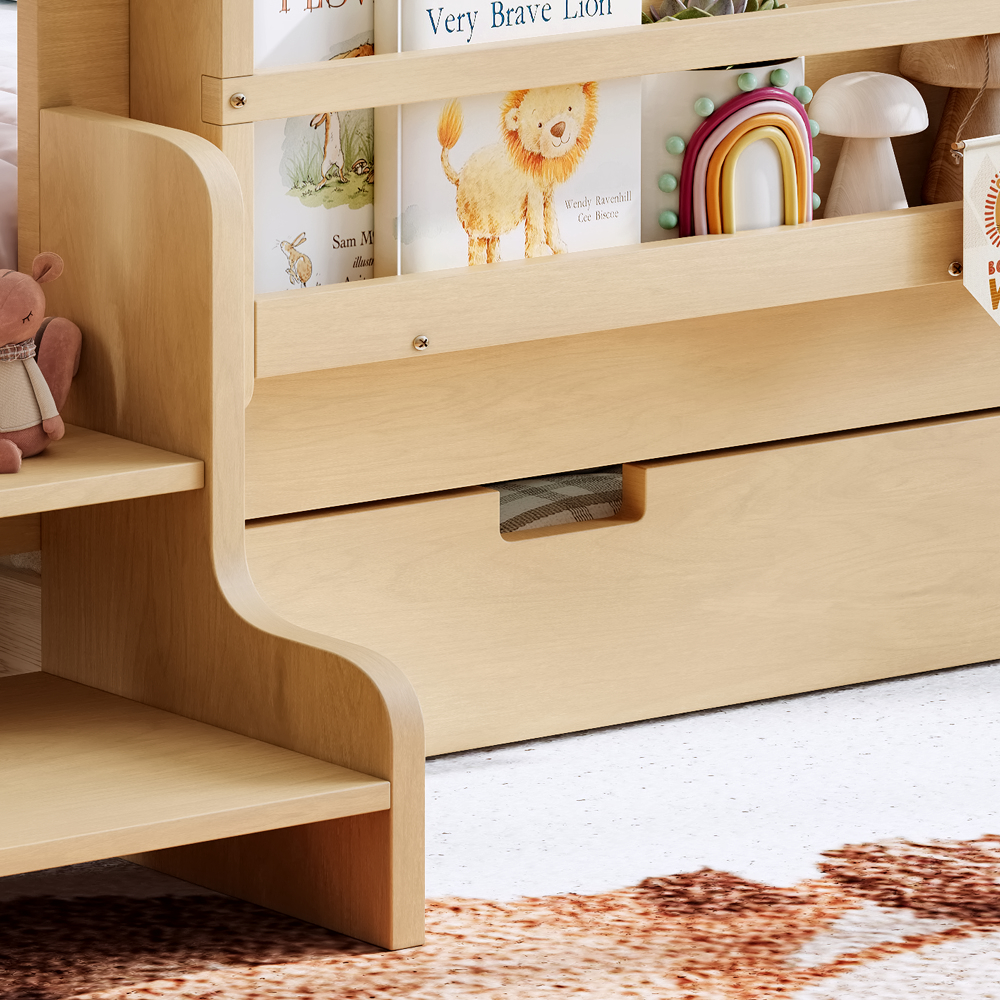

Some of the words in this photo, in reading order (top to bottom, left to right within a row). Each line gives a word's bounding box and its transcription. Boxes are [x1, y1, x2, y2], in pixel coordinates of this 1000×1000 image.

[425, 7, 478, 43] Very
[490, 0, 552, 29] Brave
[564, 196, 592, 211] Wendy
[595, 190, 632, 206] Ravenhill
[595, 209, 620, 221] Biscoe
[332, 234, 357, 250] Sam
